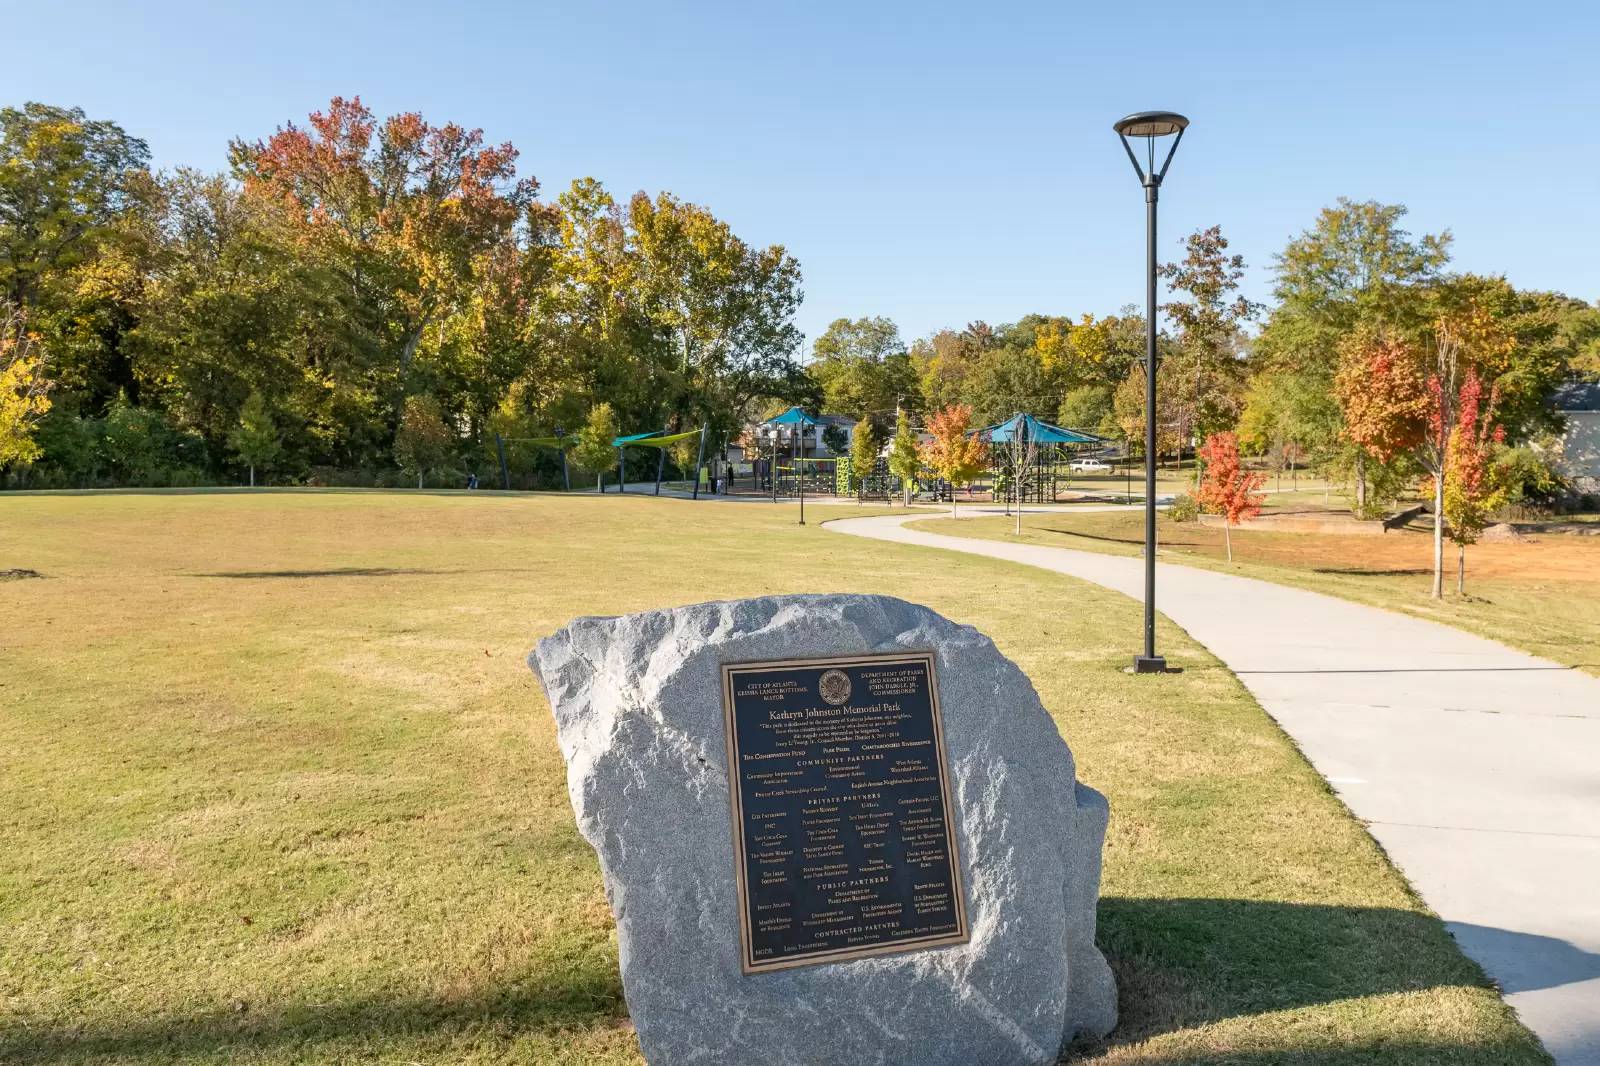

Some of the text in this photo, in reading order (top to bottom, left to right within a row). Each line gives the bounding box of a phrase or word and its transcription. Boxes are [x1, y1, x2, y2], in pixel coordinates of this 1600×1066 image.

[769, 701, 900, 722] Kathryn Johnston Memorial Park
[796, 753, 883, 766] COMMUNITY PARTNERS
[808, 792, 880, 805] PRIVATE PARTNERS
[817, 876, 888, 890] PUBLIC PARTNERS
[814, 921, 900, 938] CONTRACTED PARTNERS
